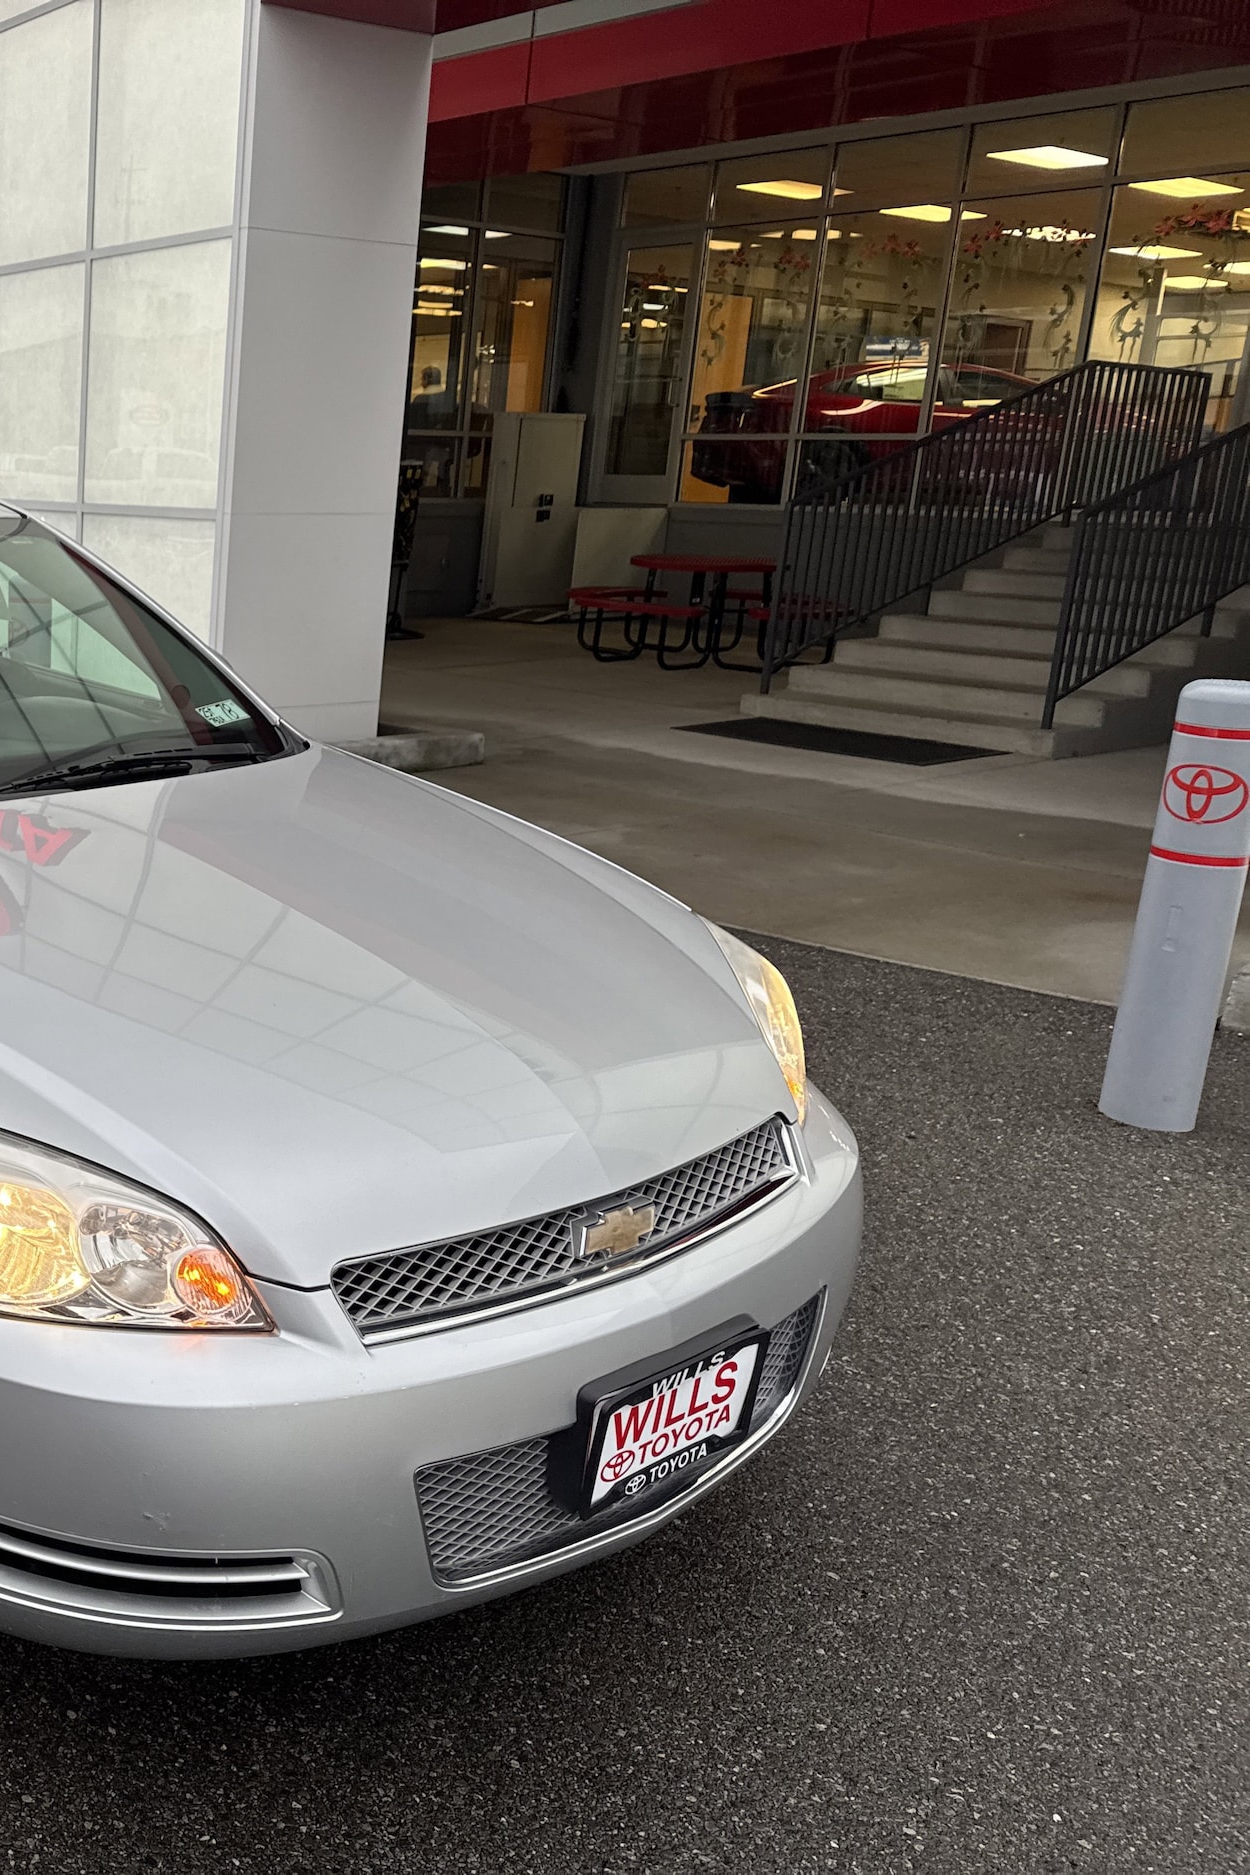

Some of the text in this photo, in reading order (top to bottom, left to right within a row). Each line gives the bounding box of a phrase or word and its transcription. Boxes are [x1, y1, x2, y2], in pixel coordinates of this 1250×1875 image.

[652, 1350, 726, 1398] WILLS
[613, 1361, 739, 1451] WILLS
[639, 1404, 731, 1464] TOYOTA
[649, 1443, 708, 1483] TOYOTA
